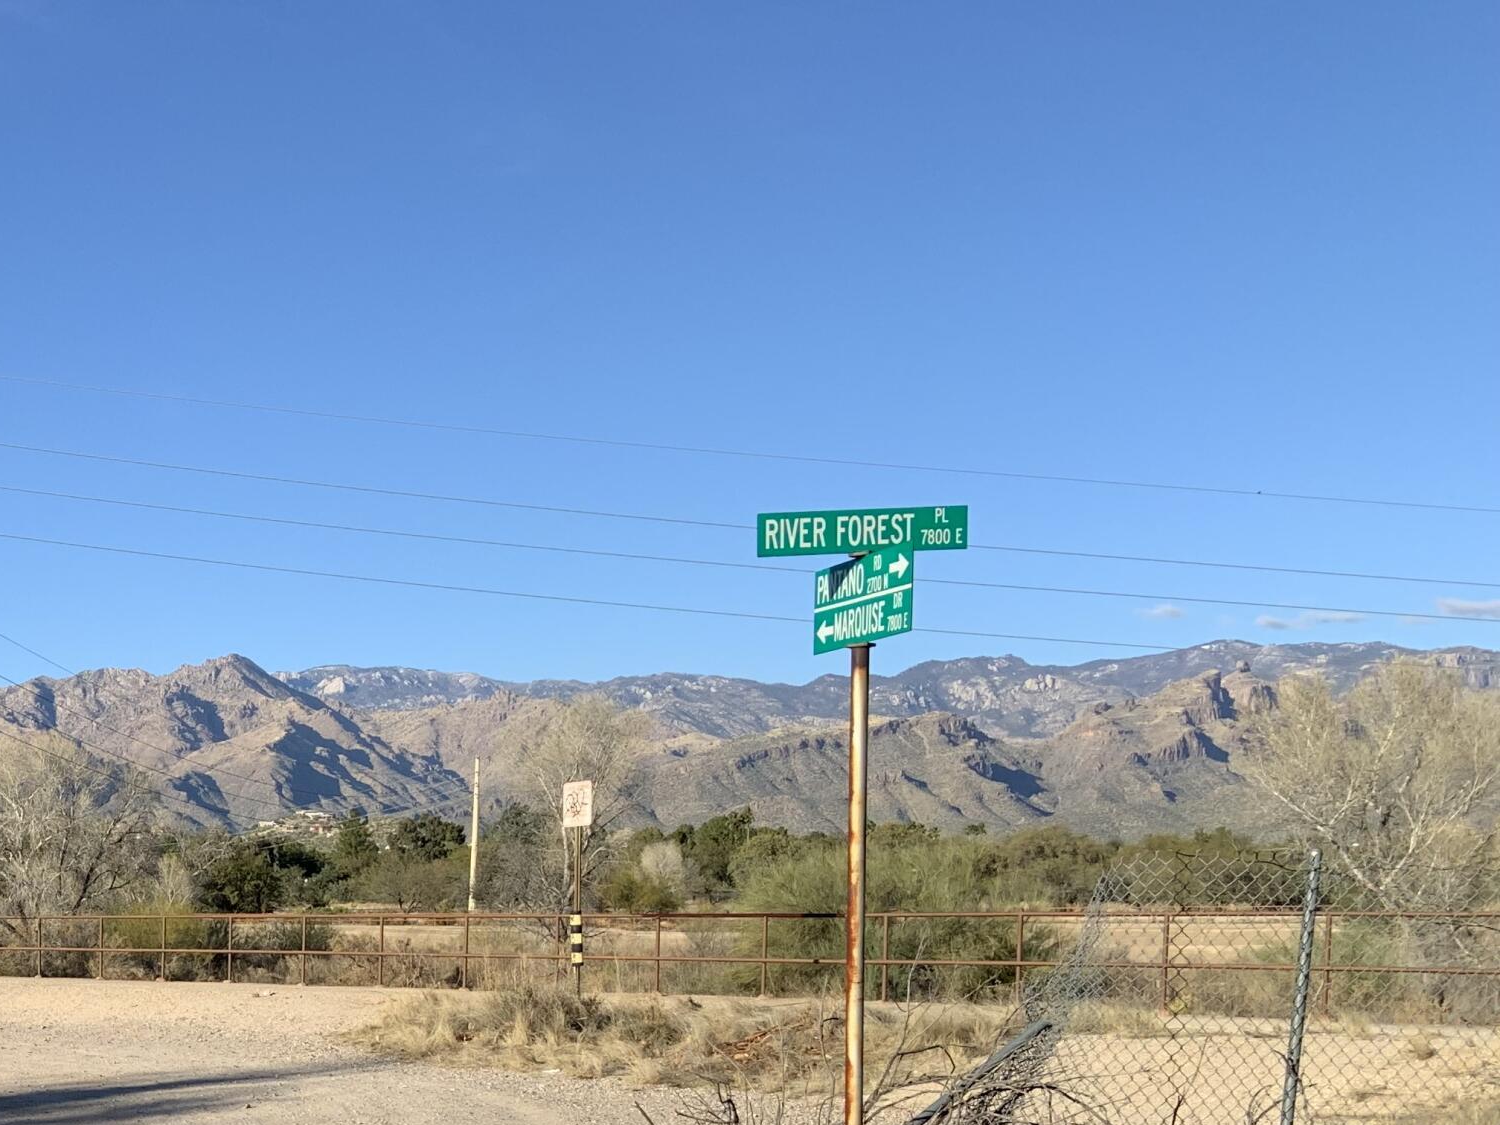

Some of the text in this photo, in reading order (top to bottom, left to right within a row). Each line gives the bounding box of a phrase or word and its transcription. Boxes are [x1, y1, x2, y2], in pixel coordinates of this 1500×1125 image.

[934, 507, 949, 524] PL
[765, 512, 915, 550] RIVER FOREST
[920, 528, 963, 545] 7800 E
[873, 554, 882, 571] RD
[817, 563, 864, 605] PANTANO
[867, 573, 889, 594] 2700 N
[893, 592, 903, 609] DR
[834, 600, 886, 642] MARQUISE
[903, 612, 909, 629] E
